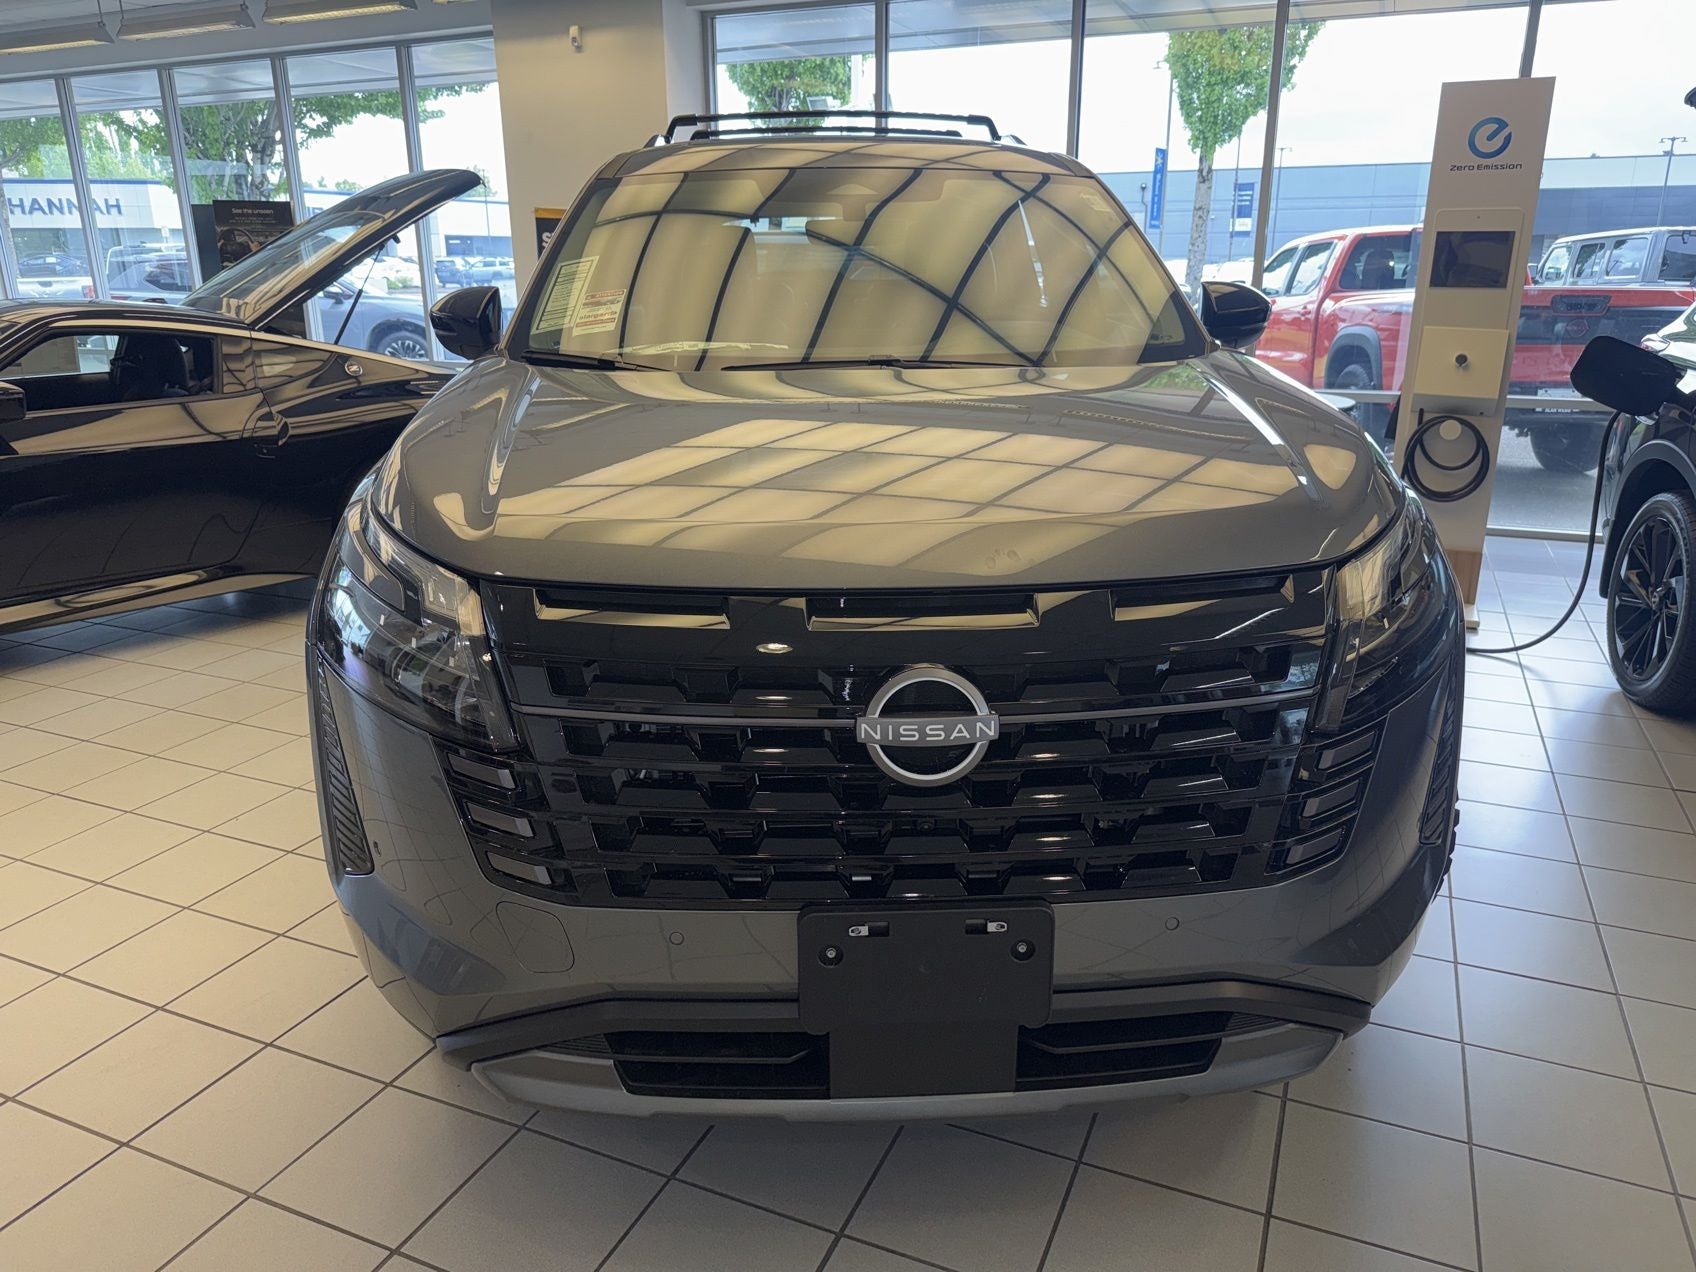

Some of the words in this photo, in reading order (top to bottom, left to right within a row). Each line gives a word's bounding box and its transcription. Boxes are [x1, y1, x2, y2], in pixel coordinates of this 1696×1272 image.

[1449, 164, 1475, 172] Zero
[1476, 163, 1523, 171] Emission
[7, 197, 122, 215] HANNAH
[860, 720, 995, 741] NISSAN
